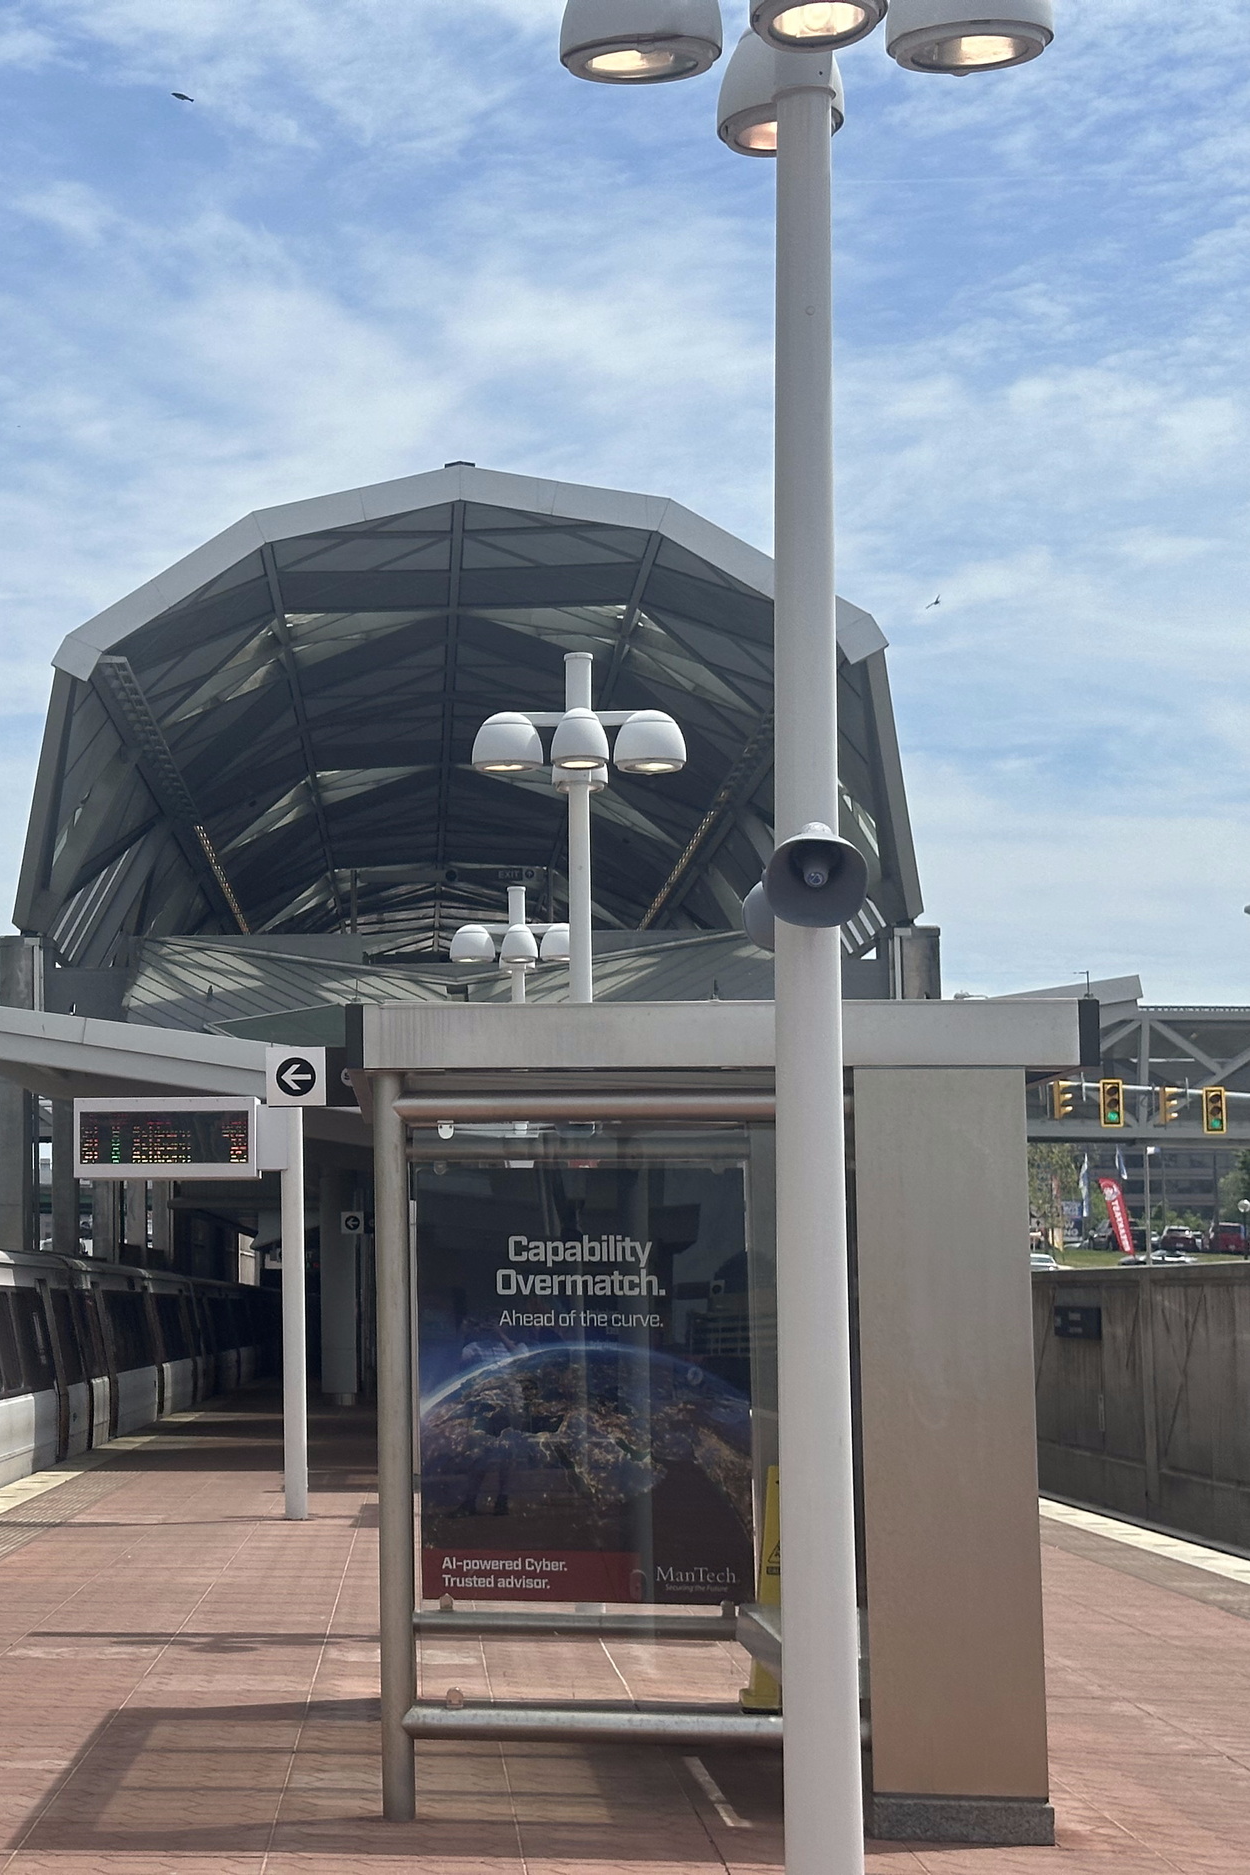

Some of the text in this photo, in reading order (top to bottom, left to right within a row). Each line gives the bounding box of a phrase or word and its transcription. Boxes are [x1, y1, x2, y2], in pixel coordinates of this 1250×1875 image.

[498, 870, 520, 879] EXIT
[508, 1234, 652, 1268] Capability
[496, 1268, 666, 1296] Overmatch.
[499, 1309, 664, 1328] Ahead of the curve.
[442, 1556, 568, 1573] AI-powered Cyber.
[442, 1574, 551, 1589] Trusted advisor.
[656, 1566, 736, 1583] ManTech
[665, 1583, 729, 1593] Securing the Future
